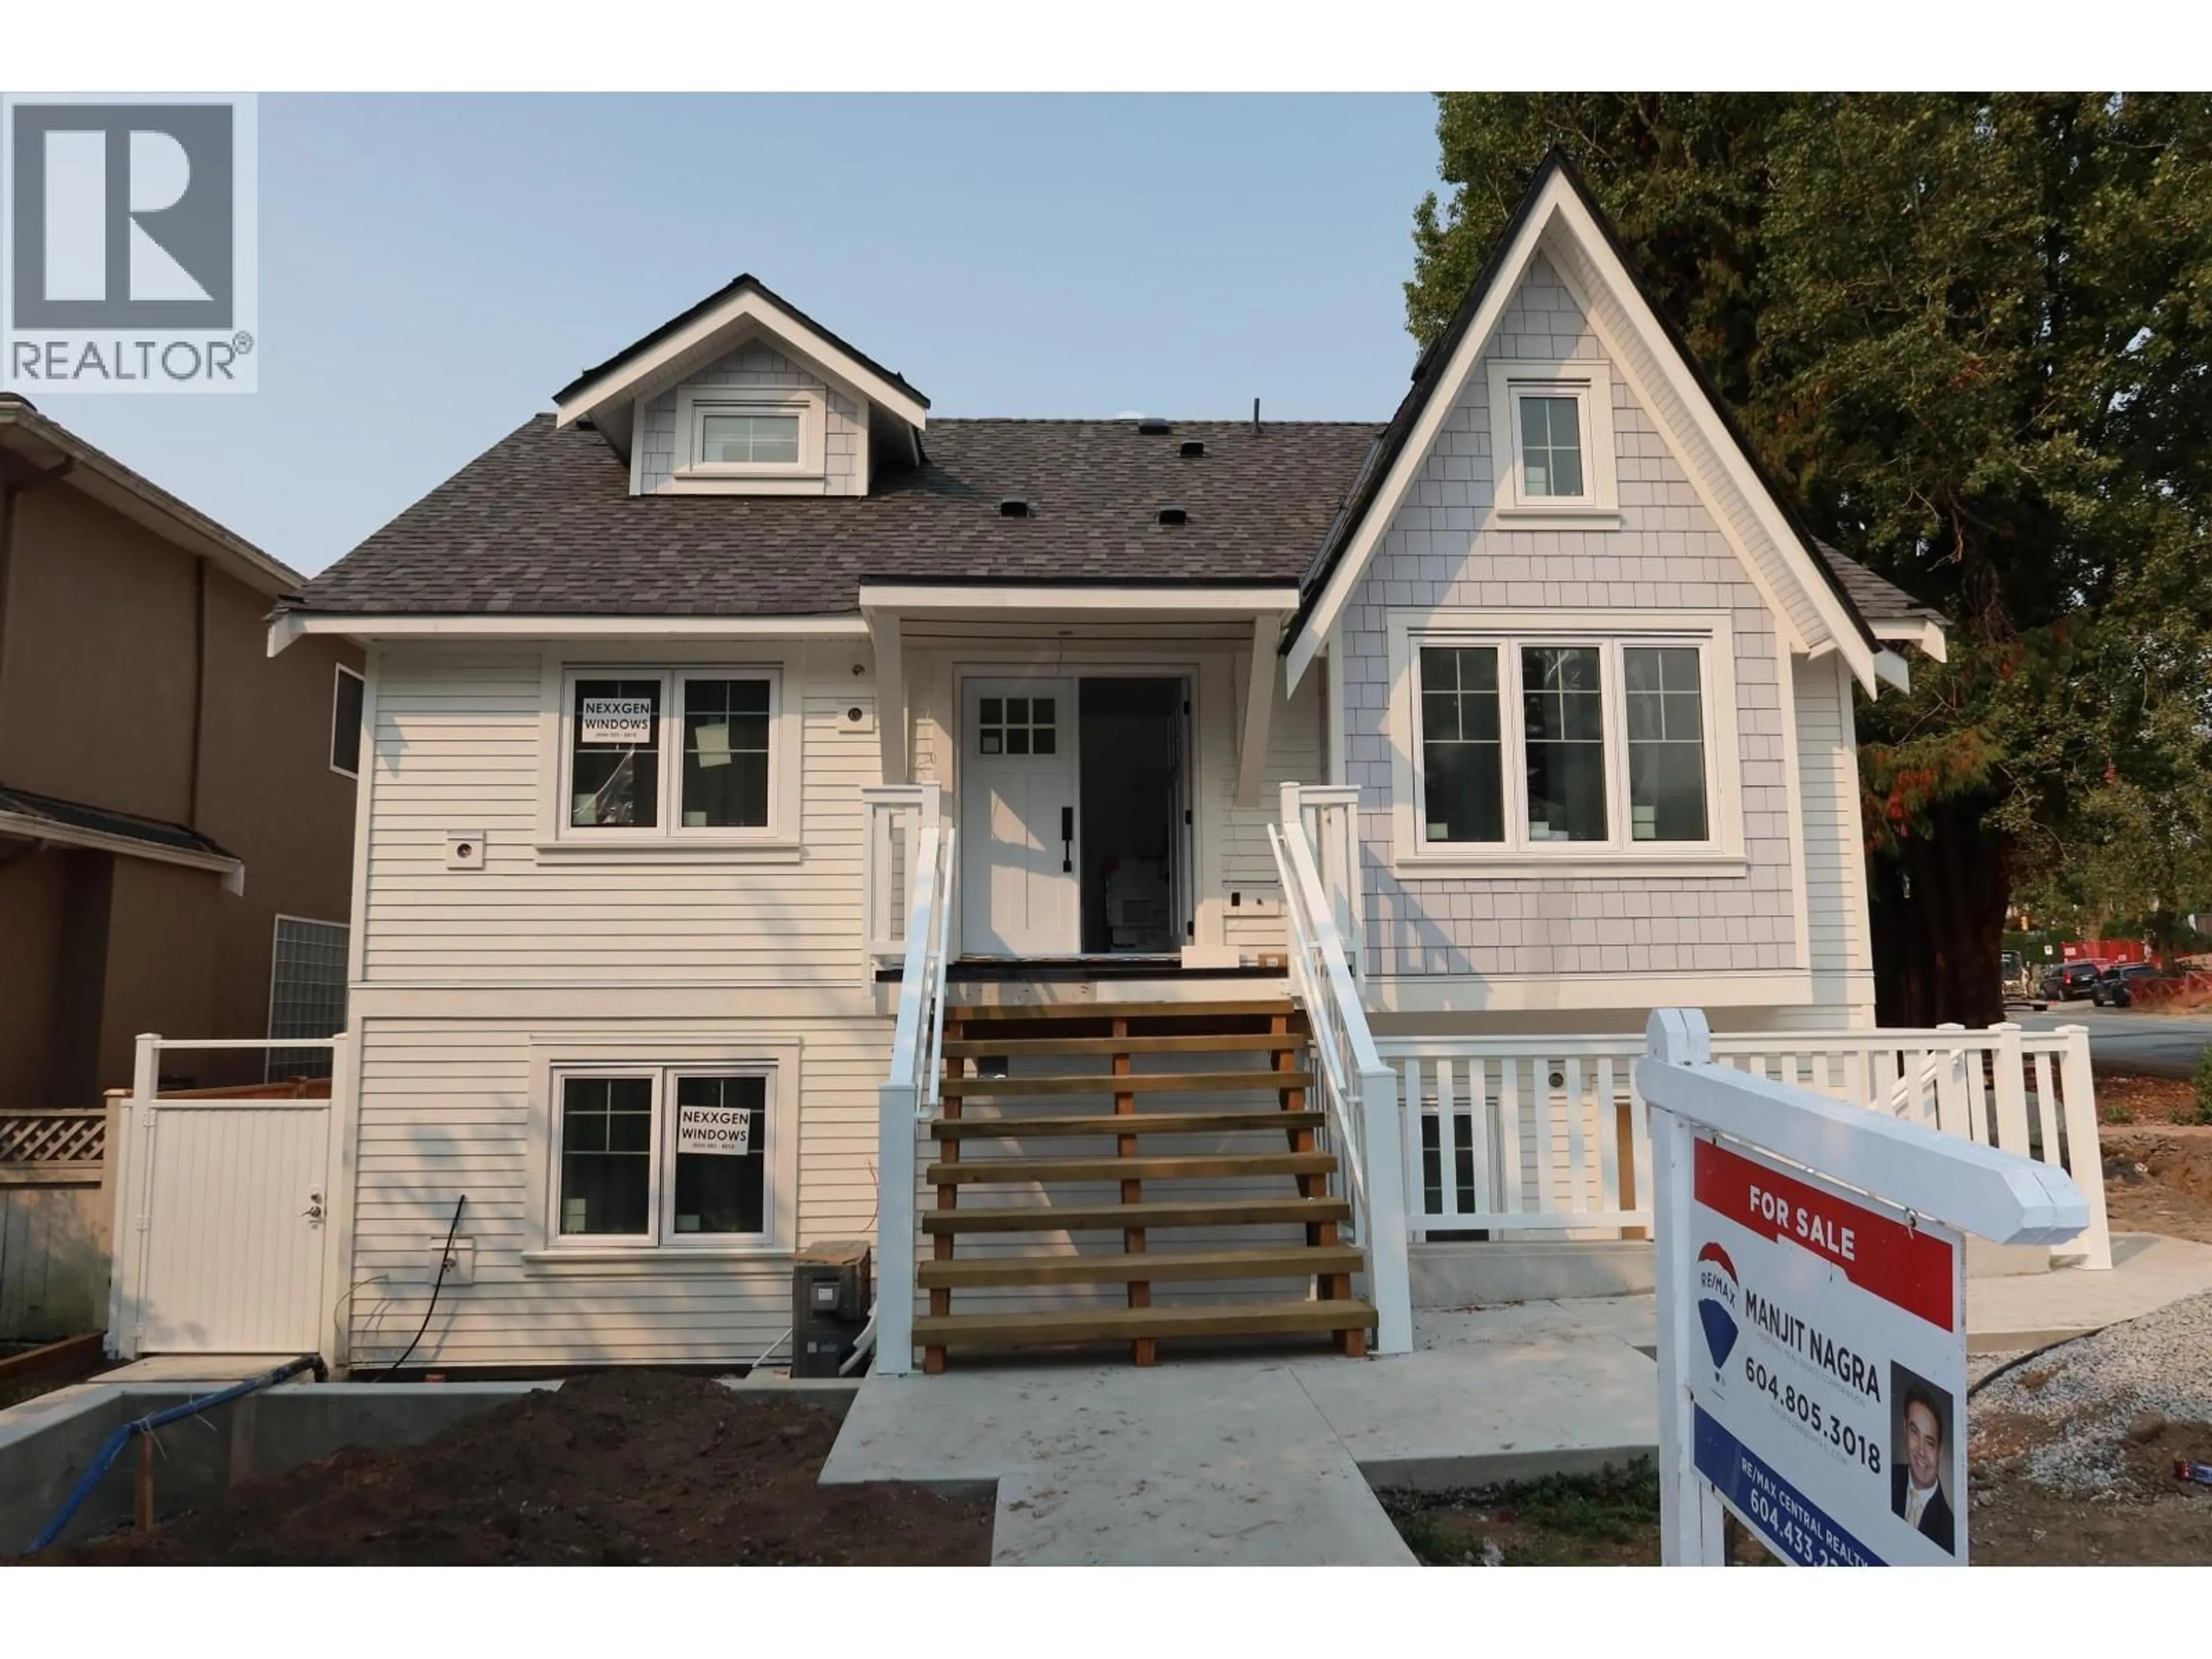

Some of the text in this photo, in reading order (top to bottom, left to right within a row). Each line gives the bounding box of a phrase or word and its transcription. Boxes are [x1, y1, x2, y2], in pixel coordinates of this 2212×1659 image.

[585, 718, 648, 729] WINDOWS
[586, 702, 649, 714] NEXXGEN
[681, 1127, 747, 1142] WINDOWS
[683, 1111, 748, 1125] NEXXGEN
[1749, 1185, 1855, 1261] FOR SALE
[1700, 1272, 1736, 1309] RE/MAX
[1745, 1289, 1805, 1353] MANJIT
[1810, 1328, 1881, 1403] NAGRA
[1745, 1357, 1881, 1474] 604.805.3018
[1741, 1457, 1777, 1497] RE/MAX
[1779, 1490, 1824, 1540] CENTRAL
